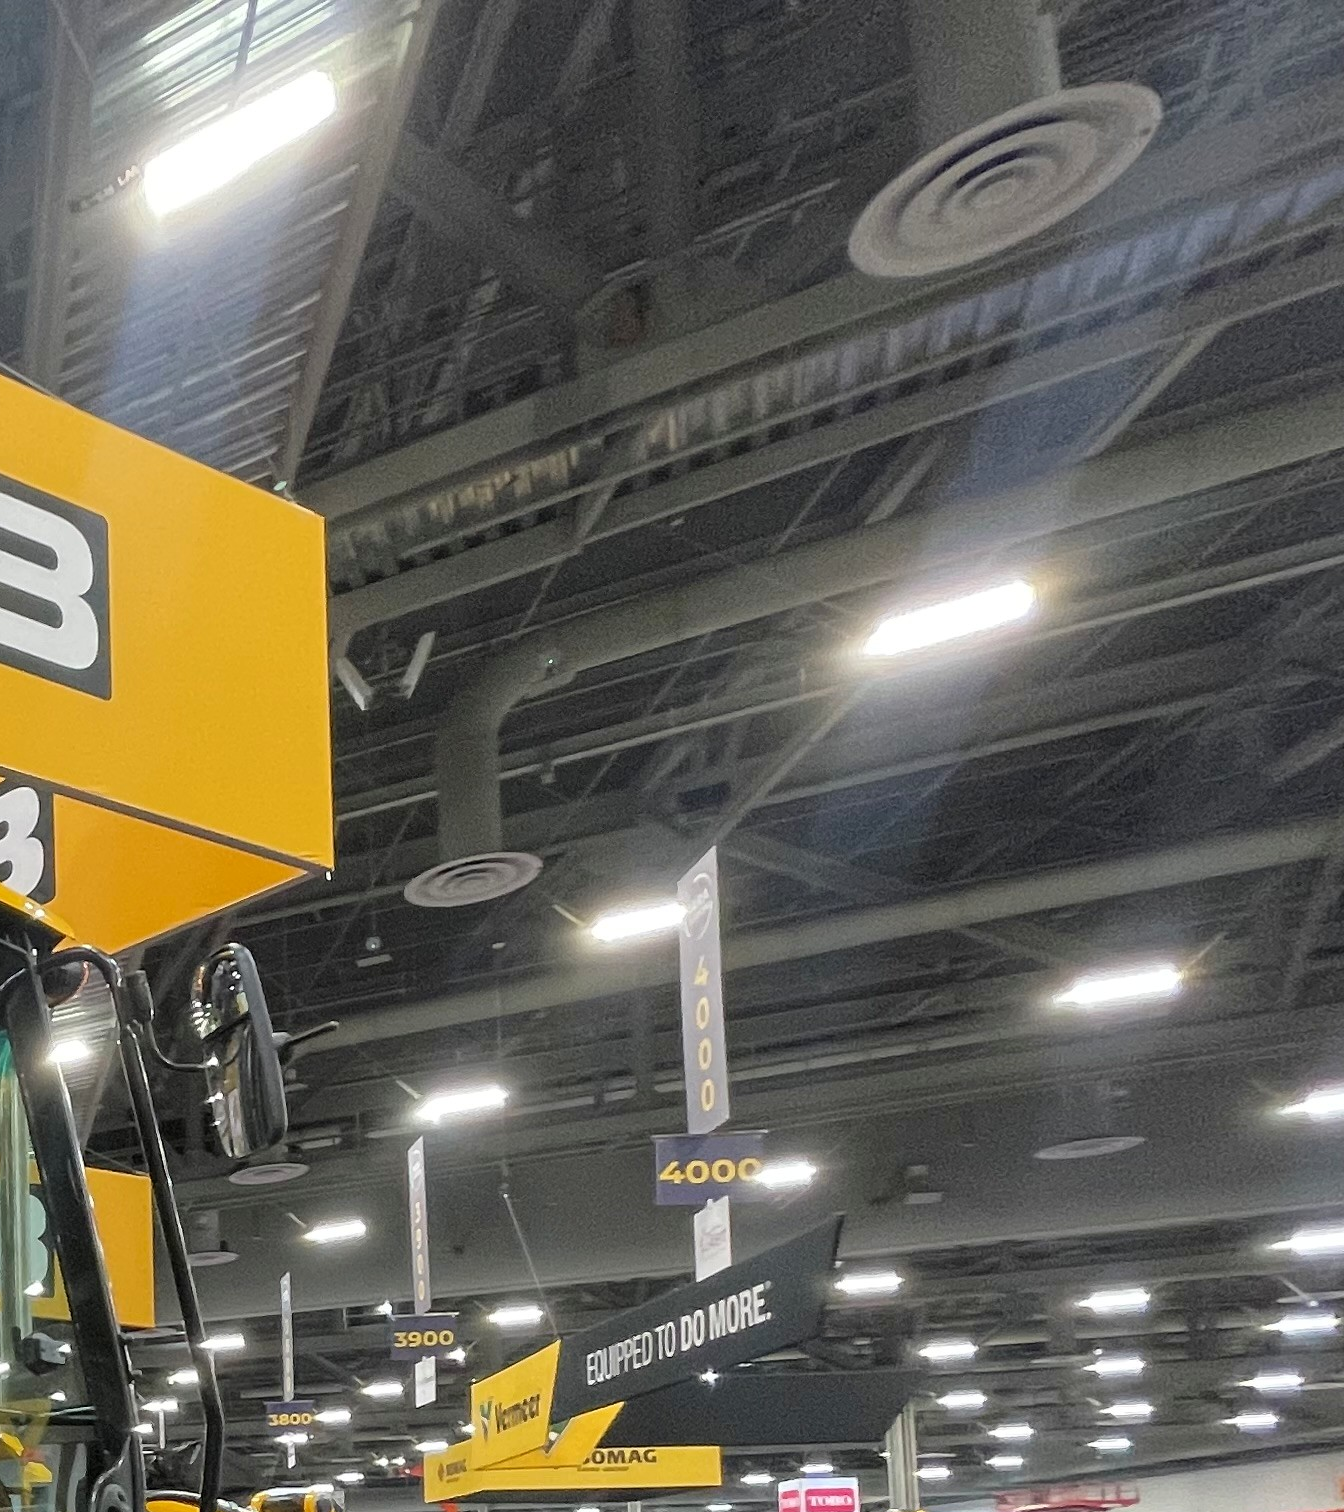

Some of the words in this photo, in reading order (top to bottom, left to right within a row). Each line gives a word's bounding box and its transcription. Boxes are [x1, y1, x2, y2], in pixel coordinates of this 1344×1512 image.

[693, 955, 716, 1113] 4000
[659, 1157, 764, 1185] 4000
[393, 1330, 455, 1348] 3900
[586, 1331, 653, 1386] EQUIPPED
[655, 1321, 676, 1360] TO
[680, 1309, 705, 1352] DO
[709, 1283, 772, 1341] MORE.
[268, 1412, 312, 1427] 3800
[494, 1393, 541, 1434] Vermeer
[583, 1449, 658, 1465] OMAG
[807, 1494, 853, 1506] TORO
